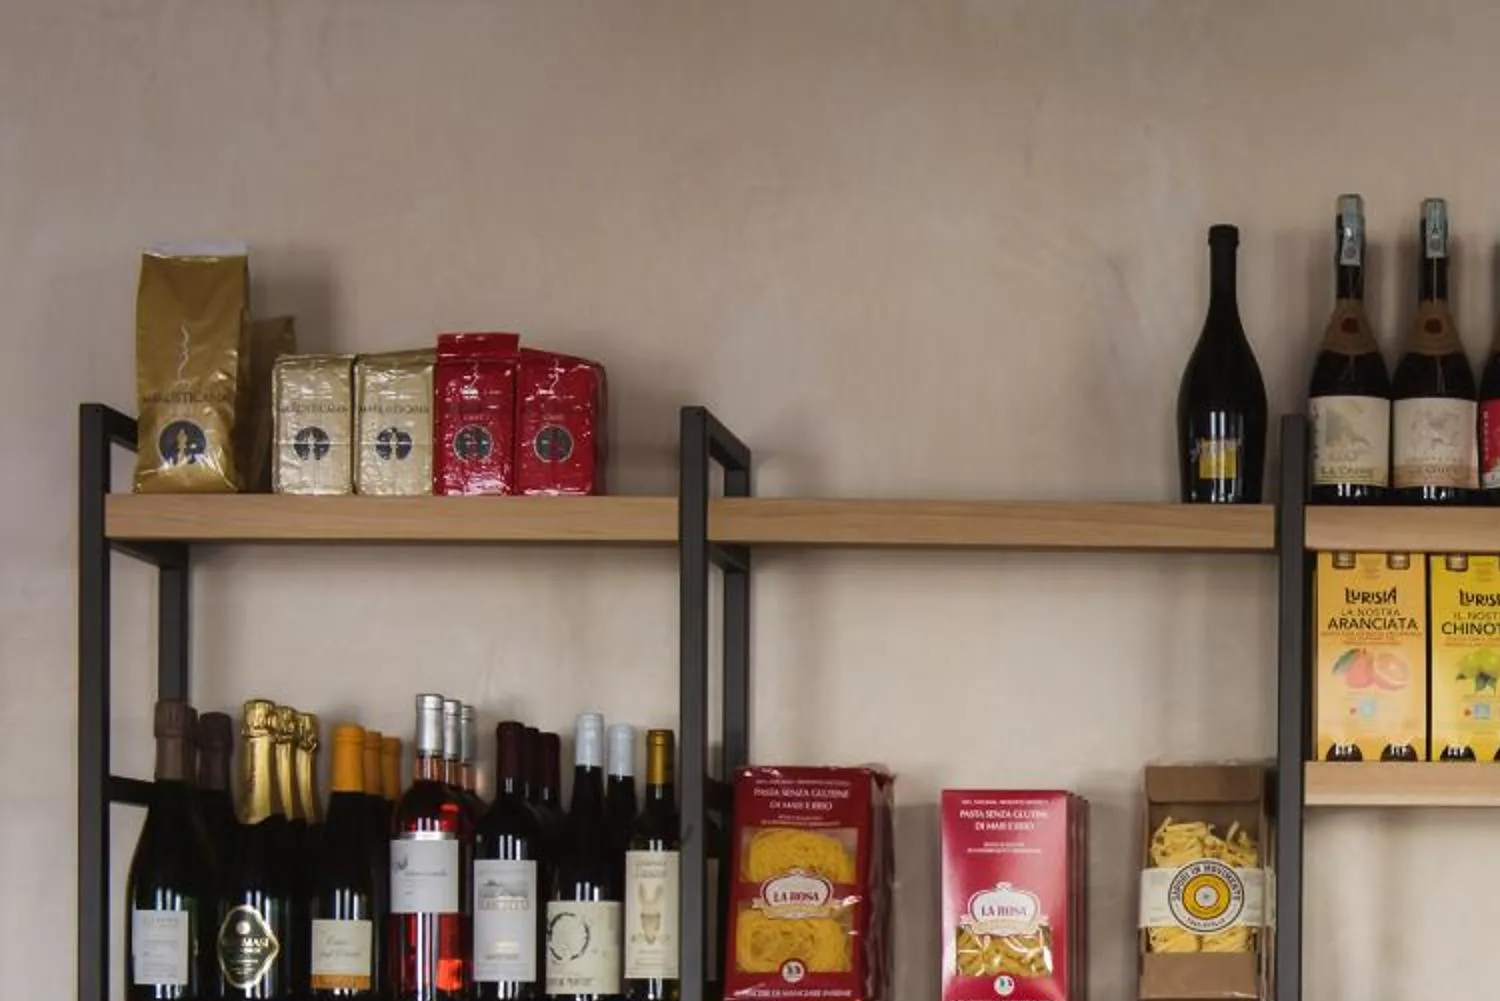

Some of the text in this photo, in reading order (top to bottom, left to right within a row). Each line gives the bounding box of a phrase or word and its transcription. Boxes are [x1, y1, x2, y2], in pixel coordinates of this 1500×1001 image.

[1345, 586, 1397, 605] LURISIA
[1328, 617, 1418, 631] ARANCIATA
[773, 891, 788, 902] LA
[981, 904, 996, 916] LA
